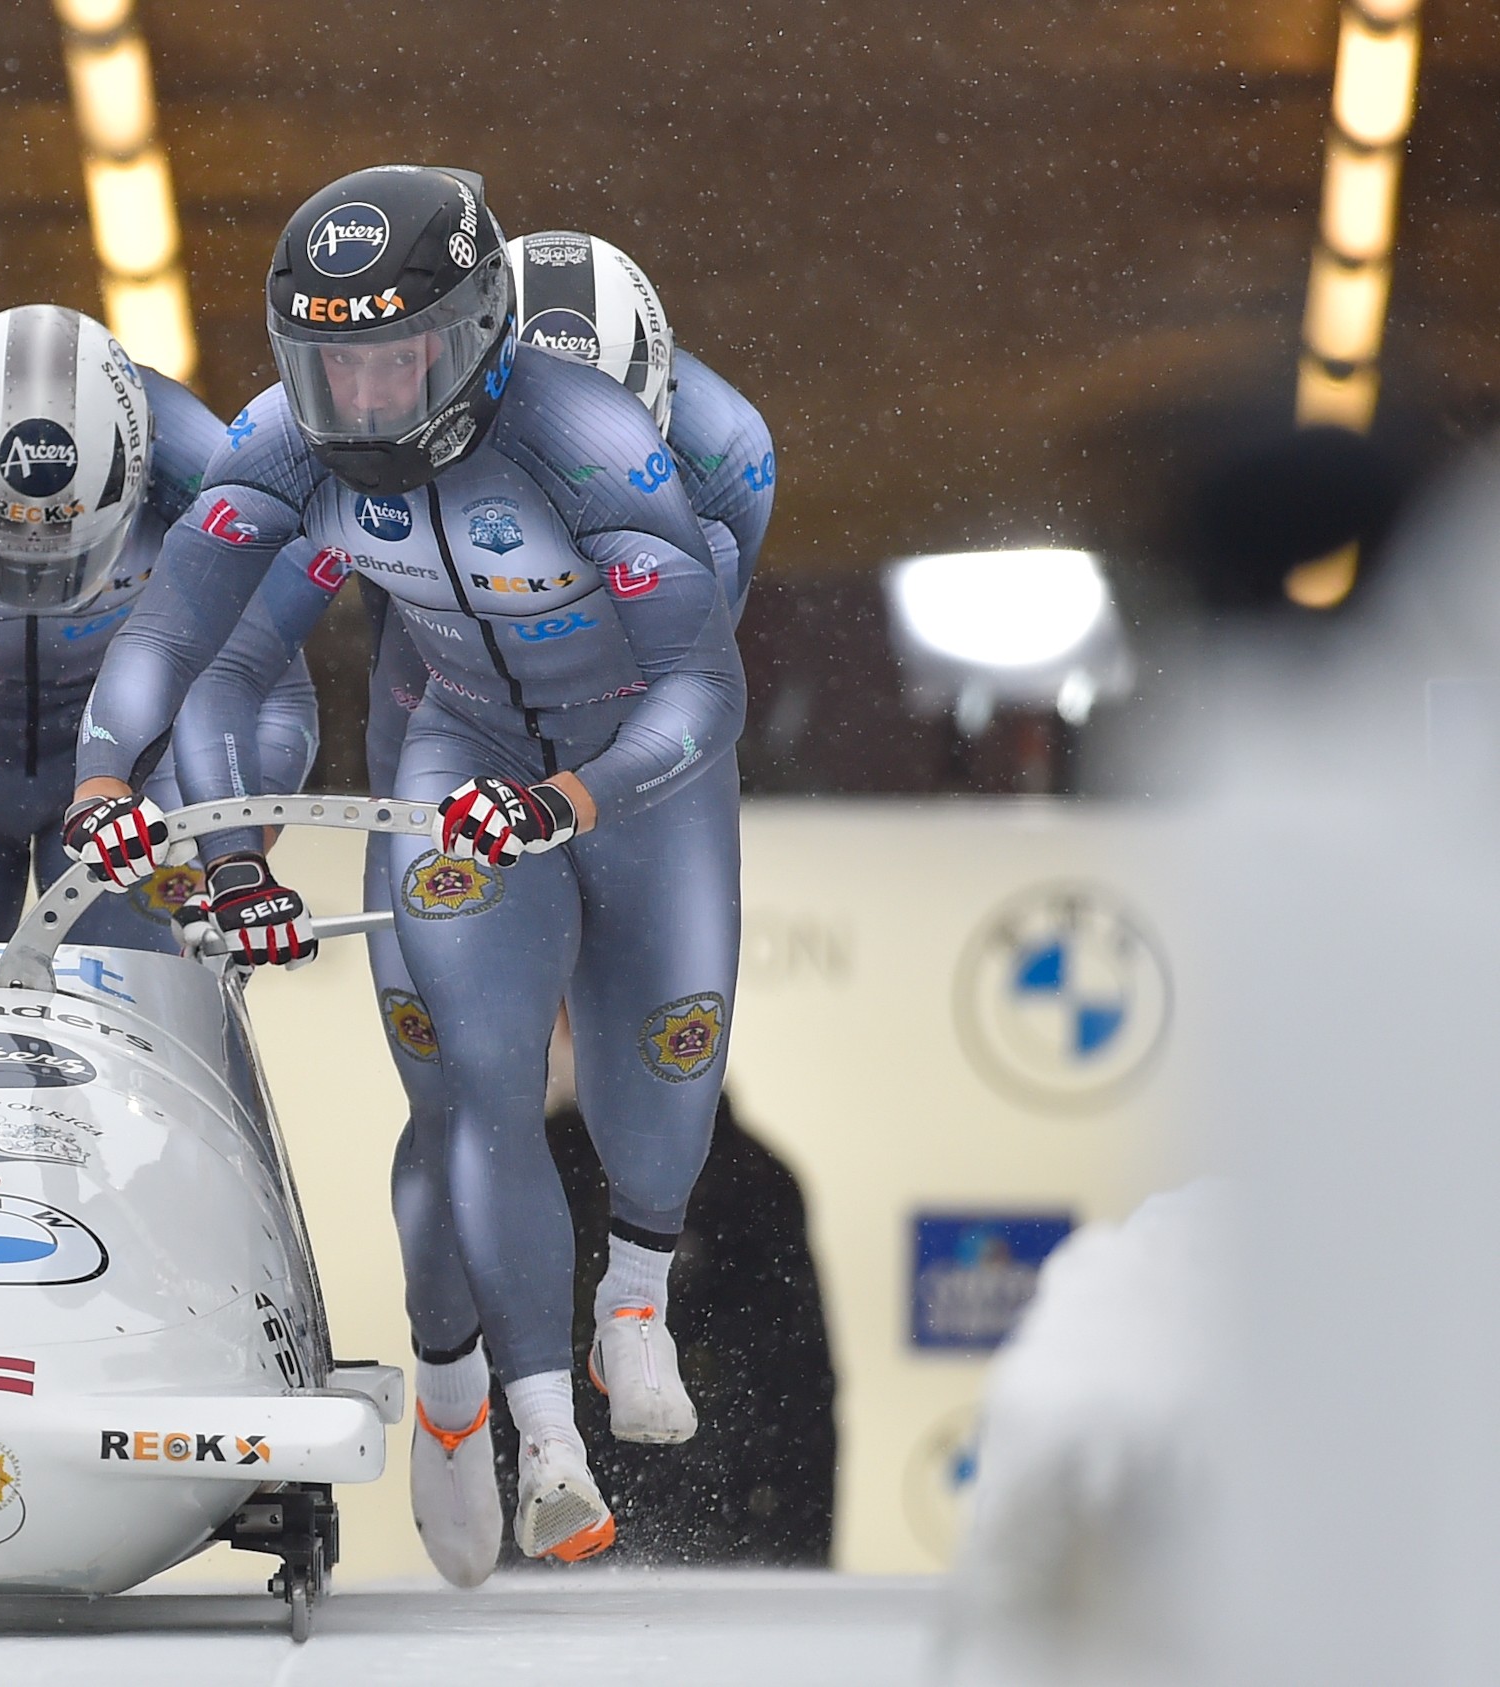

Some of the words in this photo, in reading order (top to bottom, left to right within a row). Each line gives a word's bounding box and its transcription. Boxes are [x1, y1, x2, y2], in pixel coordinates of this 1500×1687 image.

[455, 180, 477, 237] Binder
[291, 293, 376, 322] RECK
[615, 255, 661, 334] Binders
[101, 361, 141, 450] Binders
[354, 554, 440, 582] Binders
[470, 573, 551, 594] RECK
[484, 779, 527, 827] SEIZ
[240, 898, 294, 925] SEIZ
[6, 1102, 45, 1113] OF
[45, 1109, 105, 1138] RIGA
[100, 1430, 227, 1462] RECK
